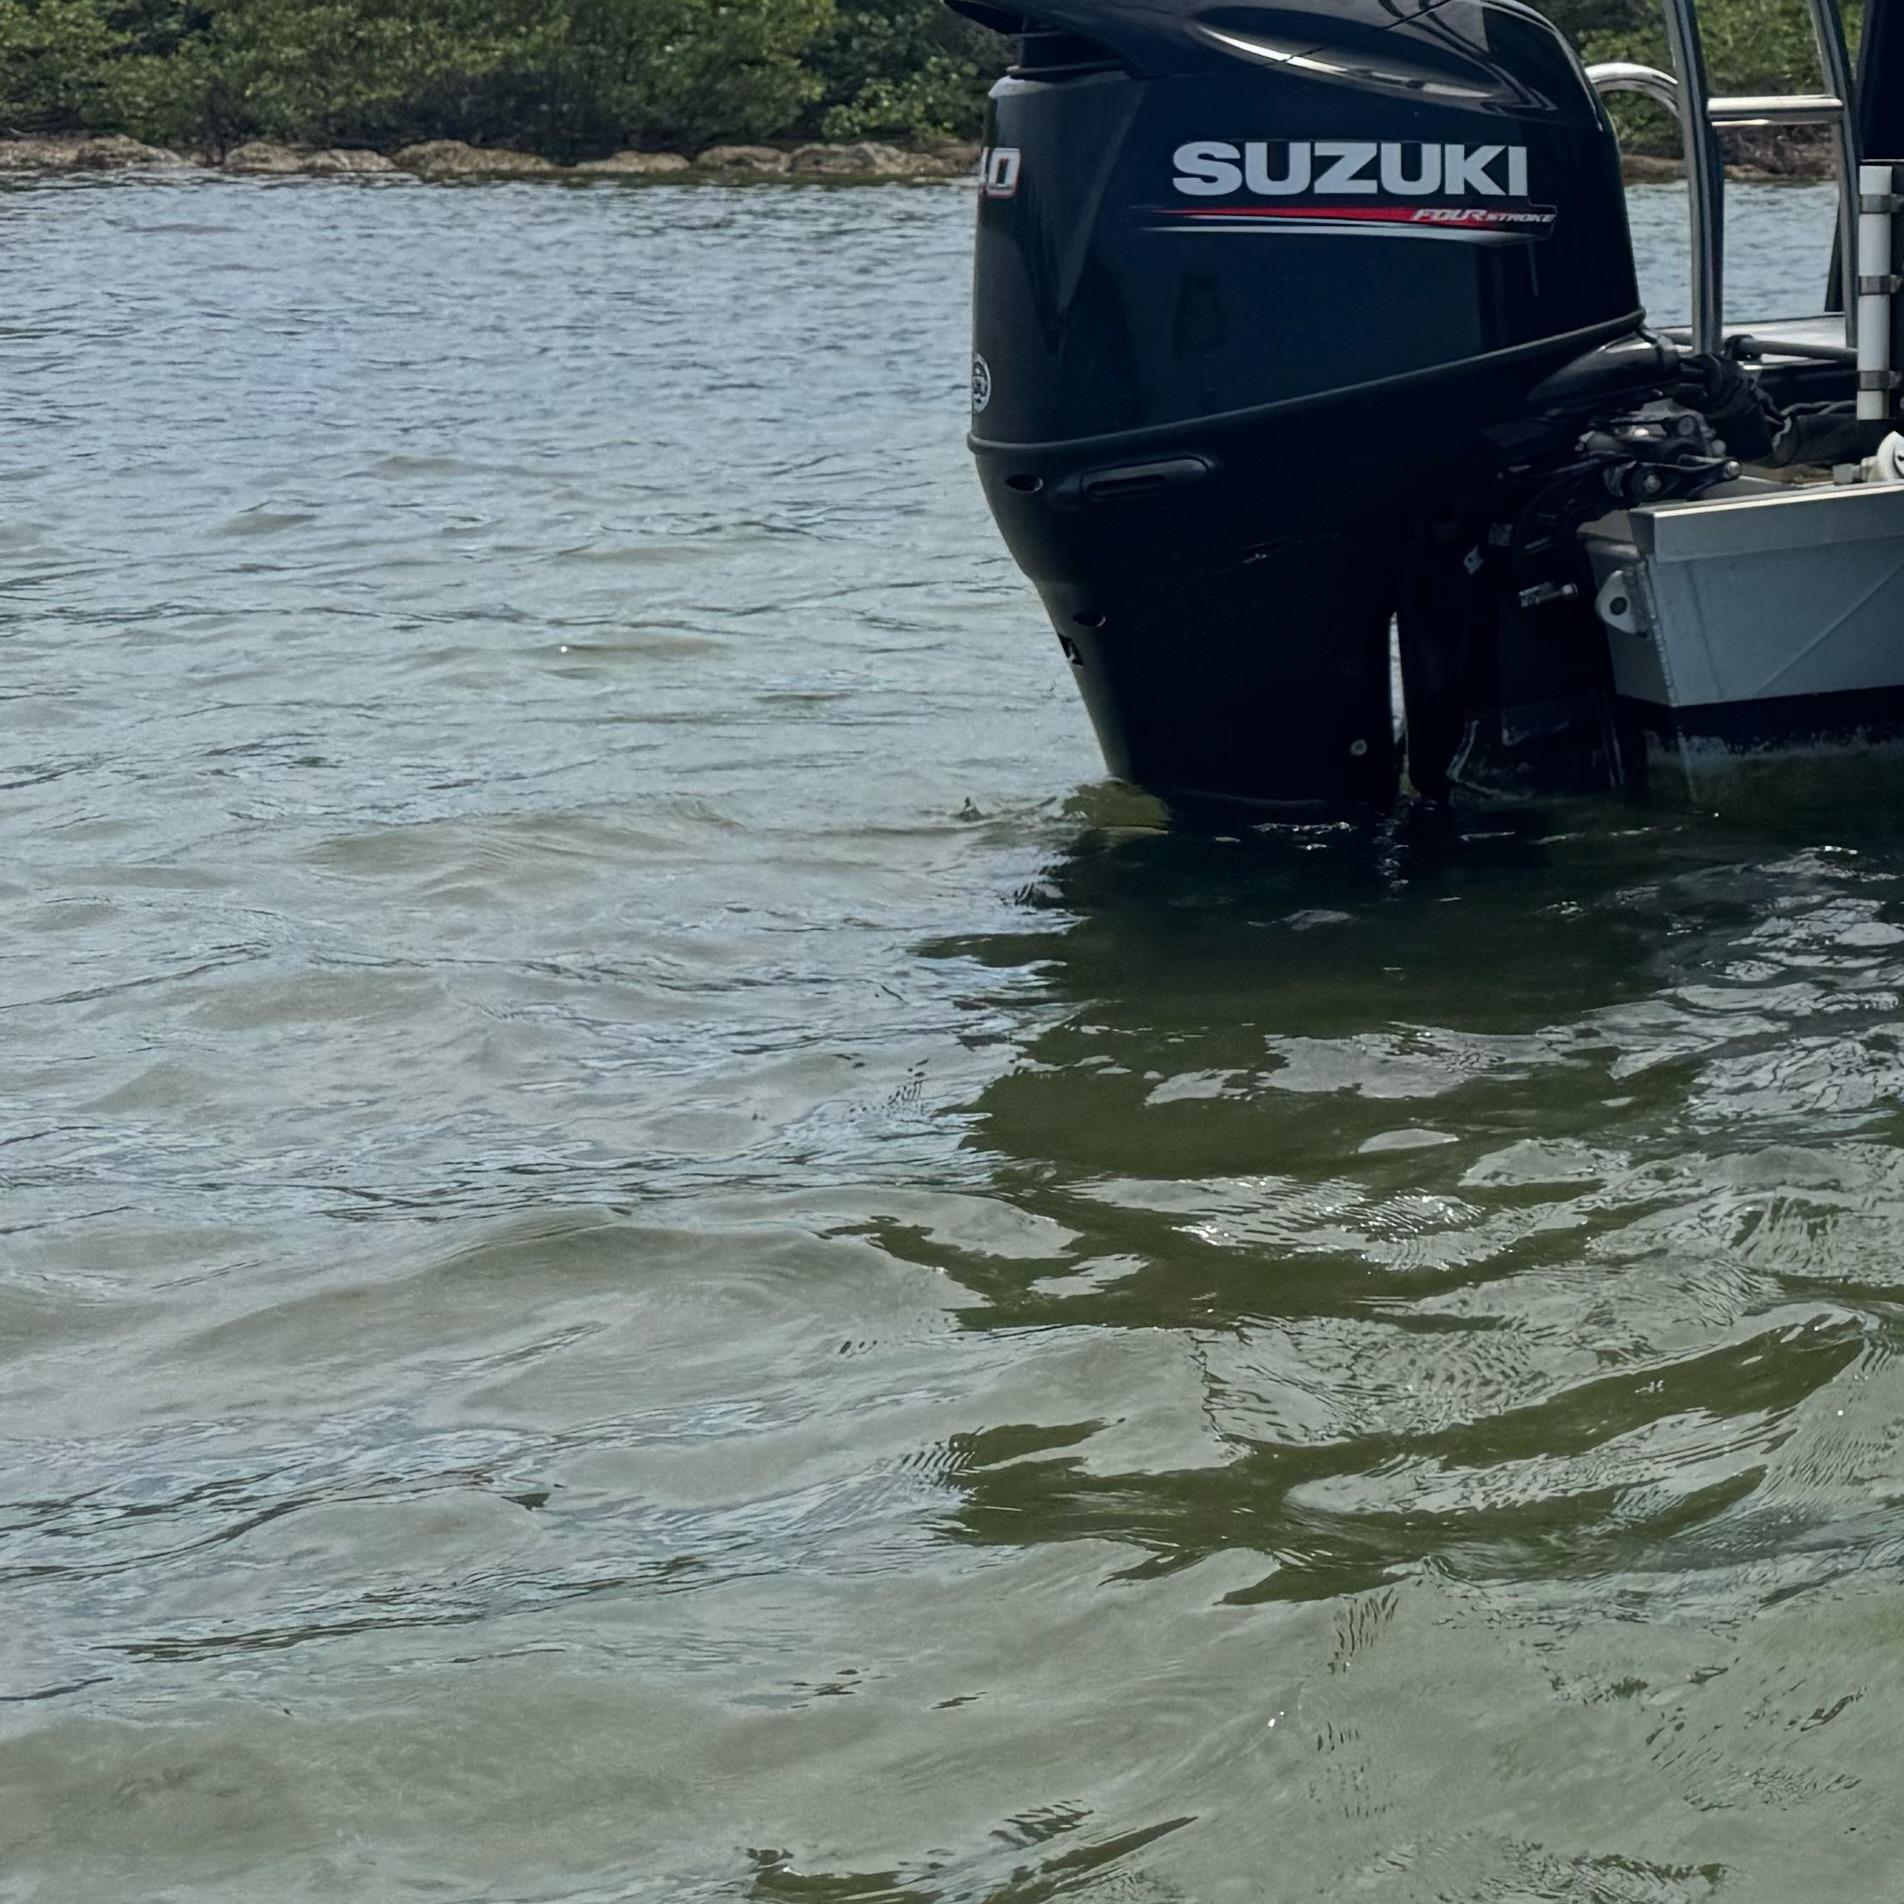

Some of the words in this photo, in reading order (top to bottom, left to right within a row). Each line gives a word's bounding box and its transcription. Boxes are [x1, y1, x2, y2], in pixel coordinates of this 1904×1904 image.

[1173, 141, 1528, 196] SUZUKI
[1410, 208, 1487, 222] FOUR
[1486, 213, 1557, 223] STROKE
